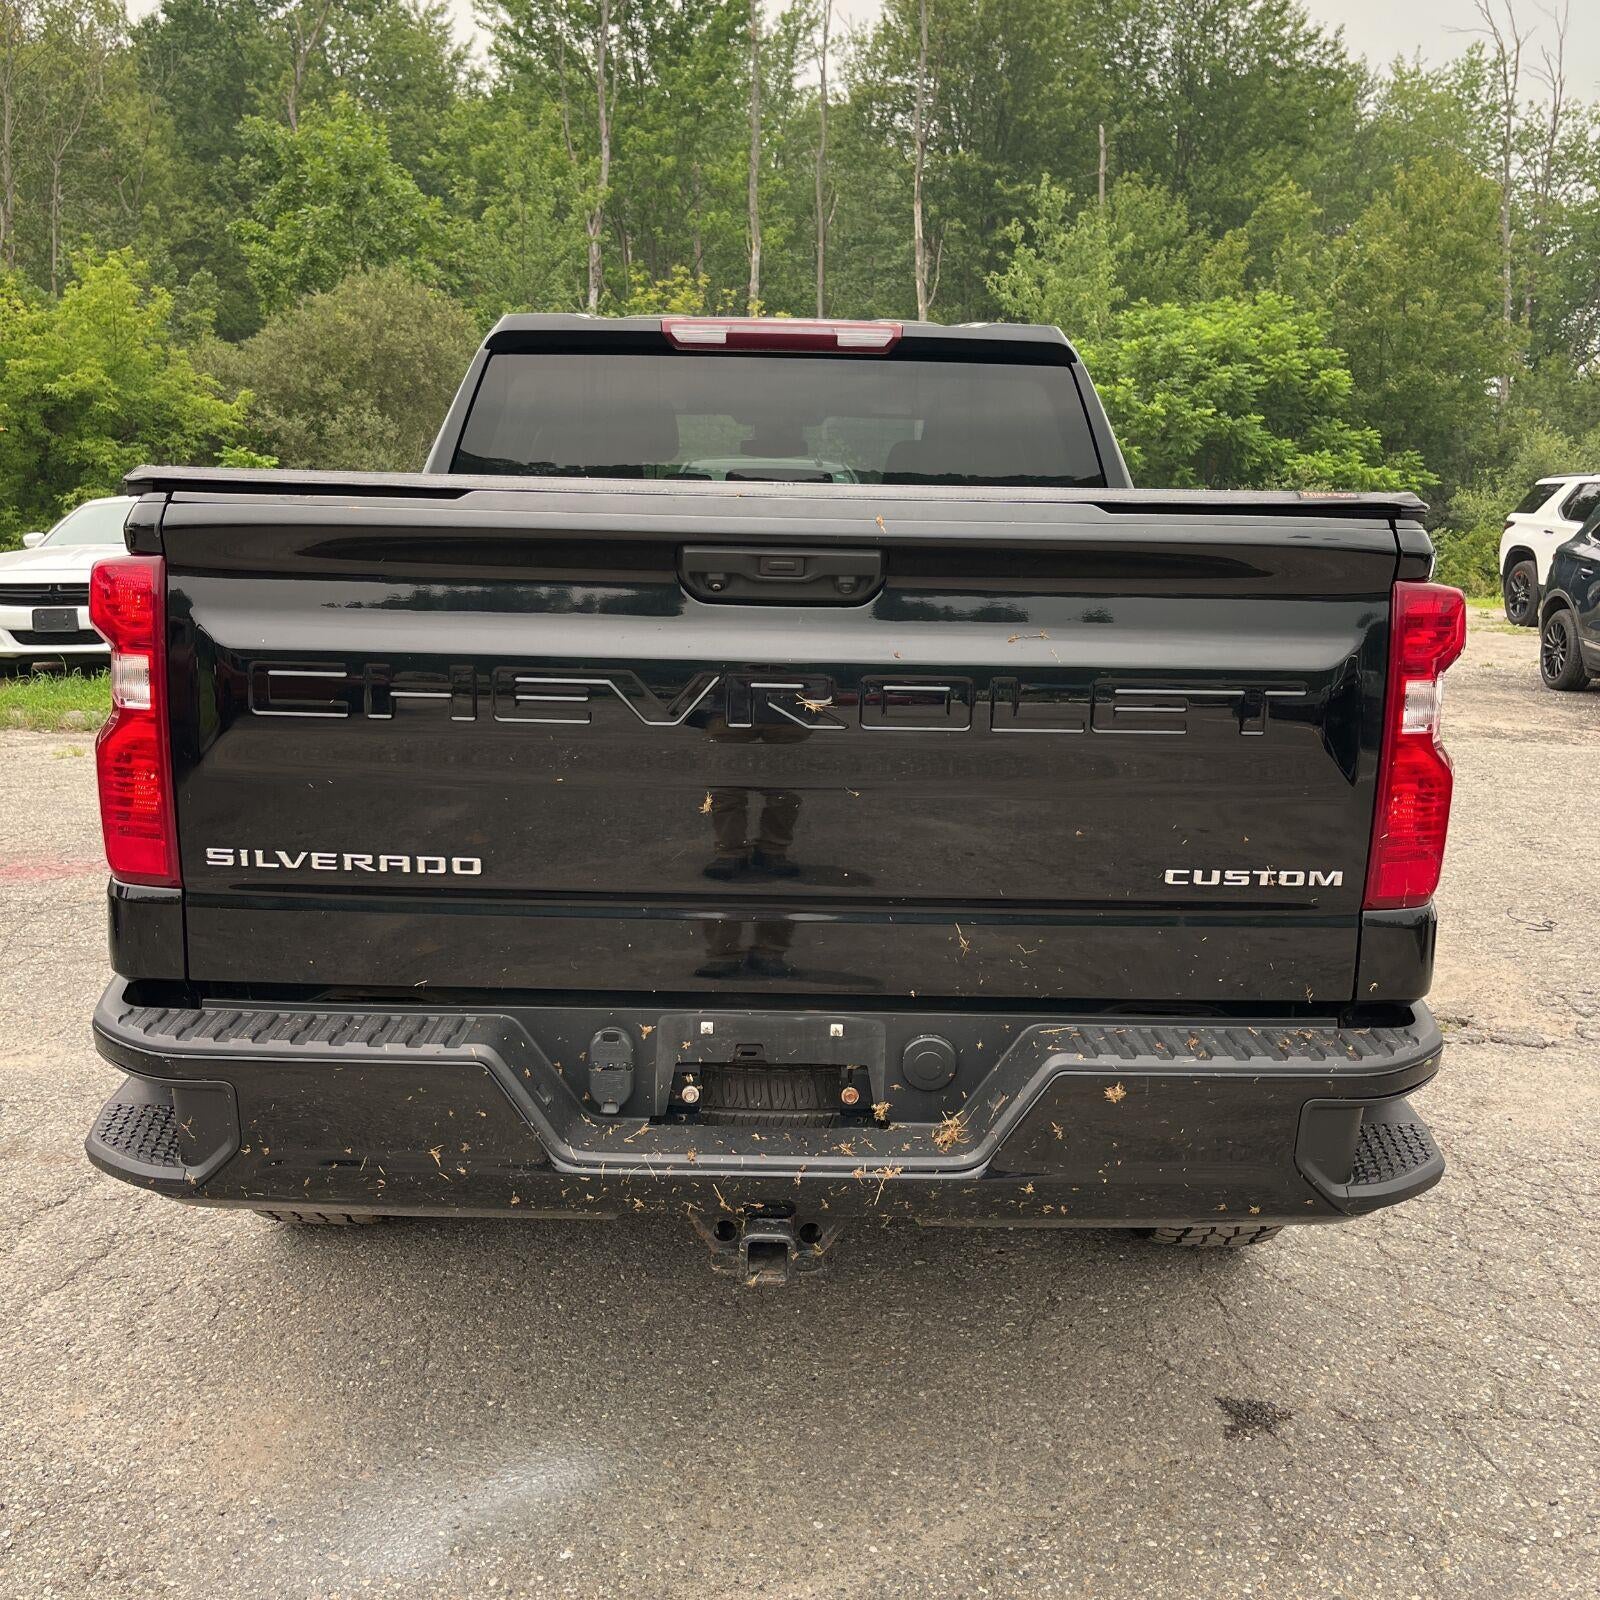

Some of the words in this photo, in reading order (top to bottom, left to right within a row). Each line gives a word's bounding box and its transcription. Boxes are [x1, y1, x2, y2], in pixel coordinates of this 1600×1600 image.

[248, 660, 1308, 736] CHEVROLET
[205, 847, 482, 875] SILVERADO
[1164, 868, 1344, 887] CUSTOM
